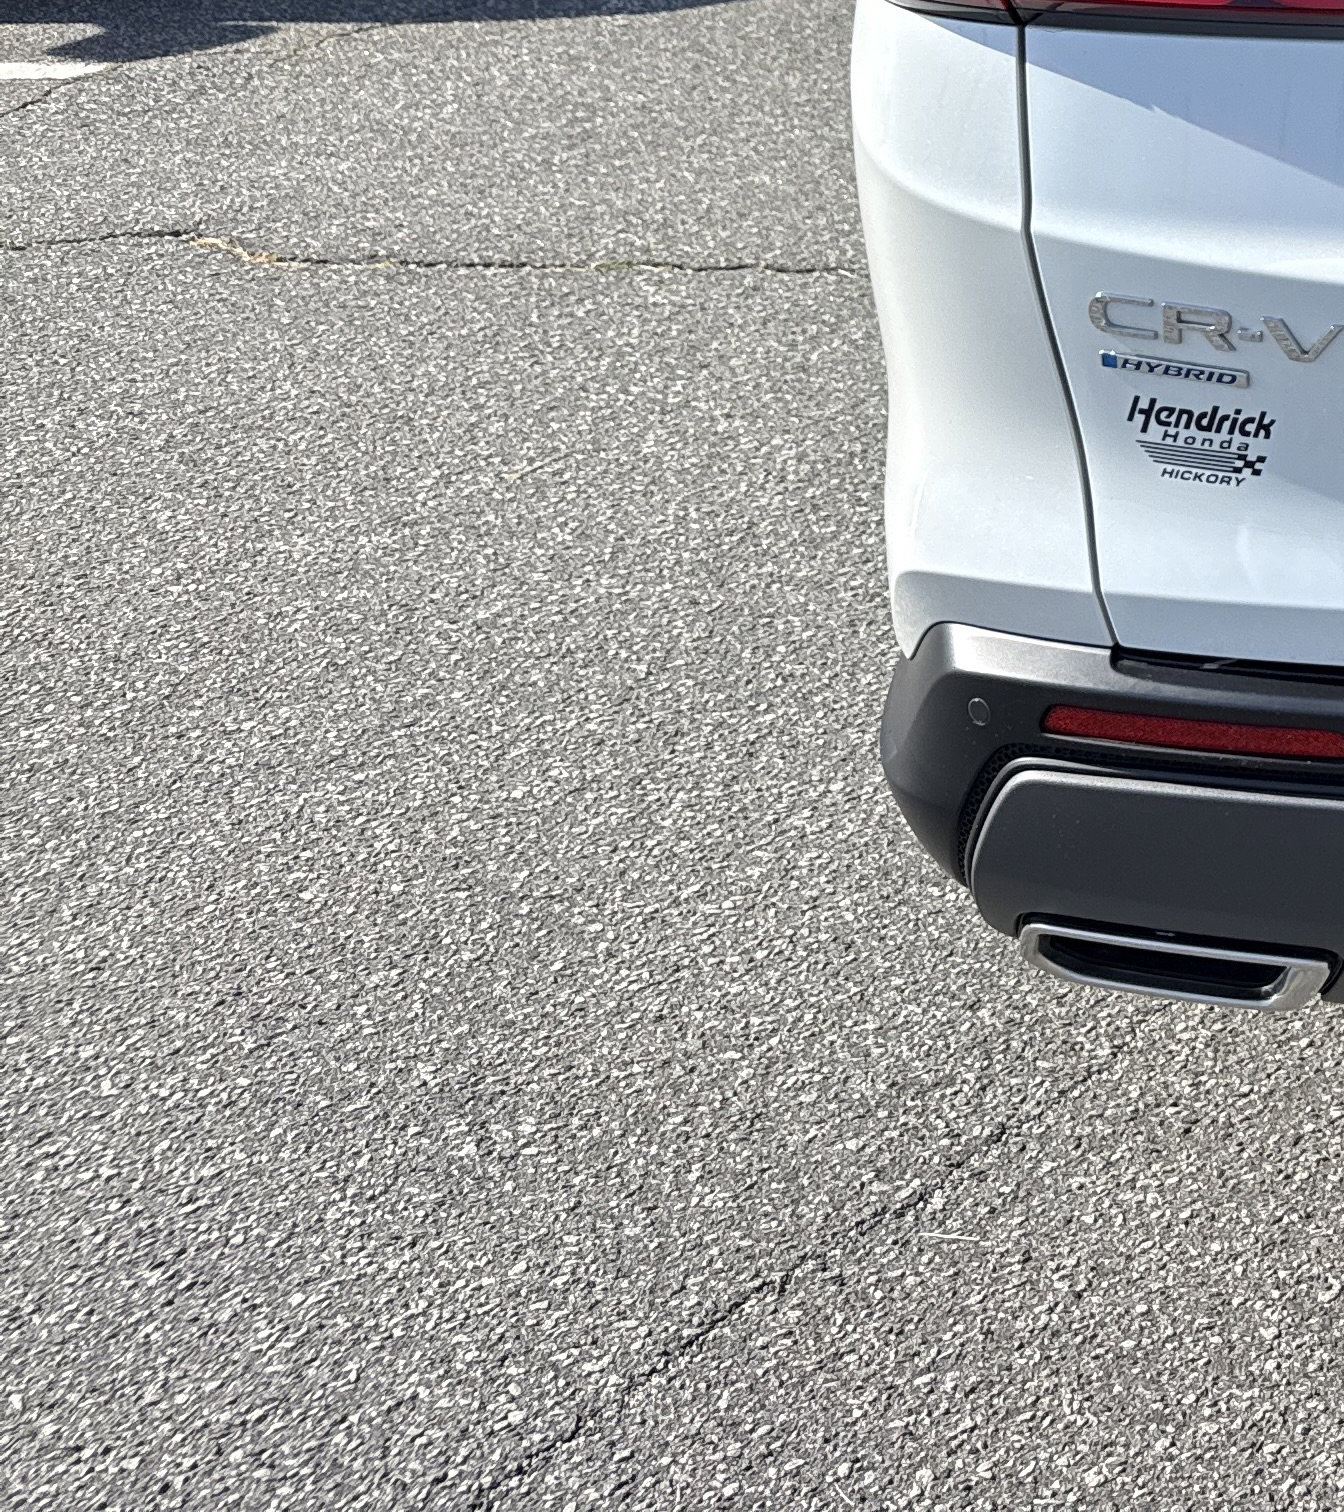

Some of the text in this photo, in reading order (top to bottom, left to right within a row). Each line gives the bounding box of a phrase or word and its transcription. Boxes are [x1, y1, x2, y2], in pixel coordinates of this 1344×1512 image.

[1088, 290, 1344, 363] CR-V
[1120, 358, 1238, 385] HYBRID
[1126, 395, 1276, 439] Hendrick
[1161, 430, 1250, 451] Honda
[1160, 467, 1246, 487] HICKORY
